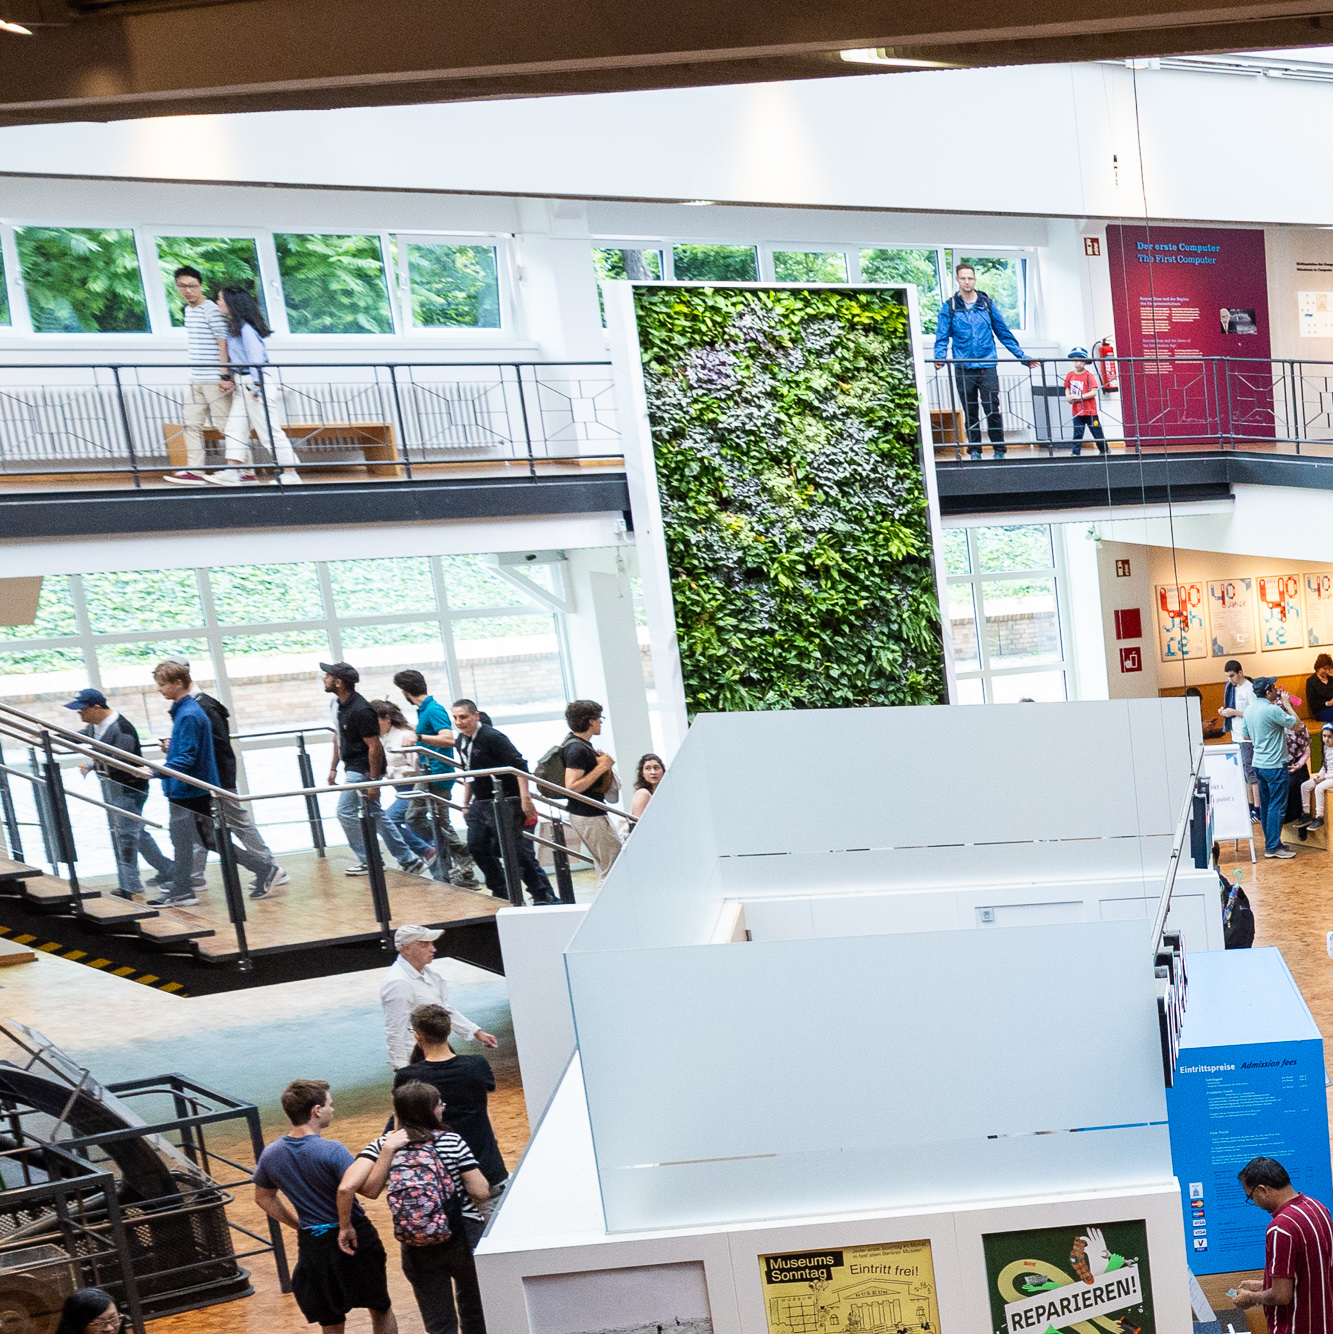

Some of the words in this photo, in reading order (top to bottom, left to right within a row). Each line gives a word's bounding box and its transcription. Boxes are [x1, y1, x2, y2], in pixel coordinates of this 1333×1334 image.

[1136, 242, 1153, 250] Der
[1179, 243, 1220, 253] Computer
[1137, 254, 1154, 262] The
[1156, 254, 1176, 263] First
[1177, 255, 1216, 265] Computer
[1180, 1063, 1235, 1074] Eintrittspreise
[1240, 1060, 1280, 1069] Admission
[1281, 1059, 1297, 1068] fees
[770, 1255, 834, 1269] Museums
[772, 1268, 827, 1282] Sonntag
[850, 1264, 891, 1274] Eintritt
[895, 1266, 918, 1276] frei!
[1011, 1276, 1137, 1331] REPARIEREN!
